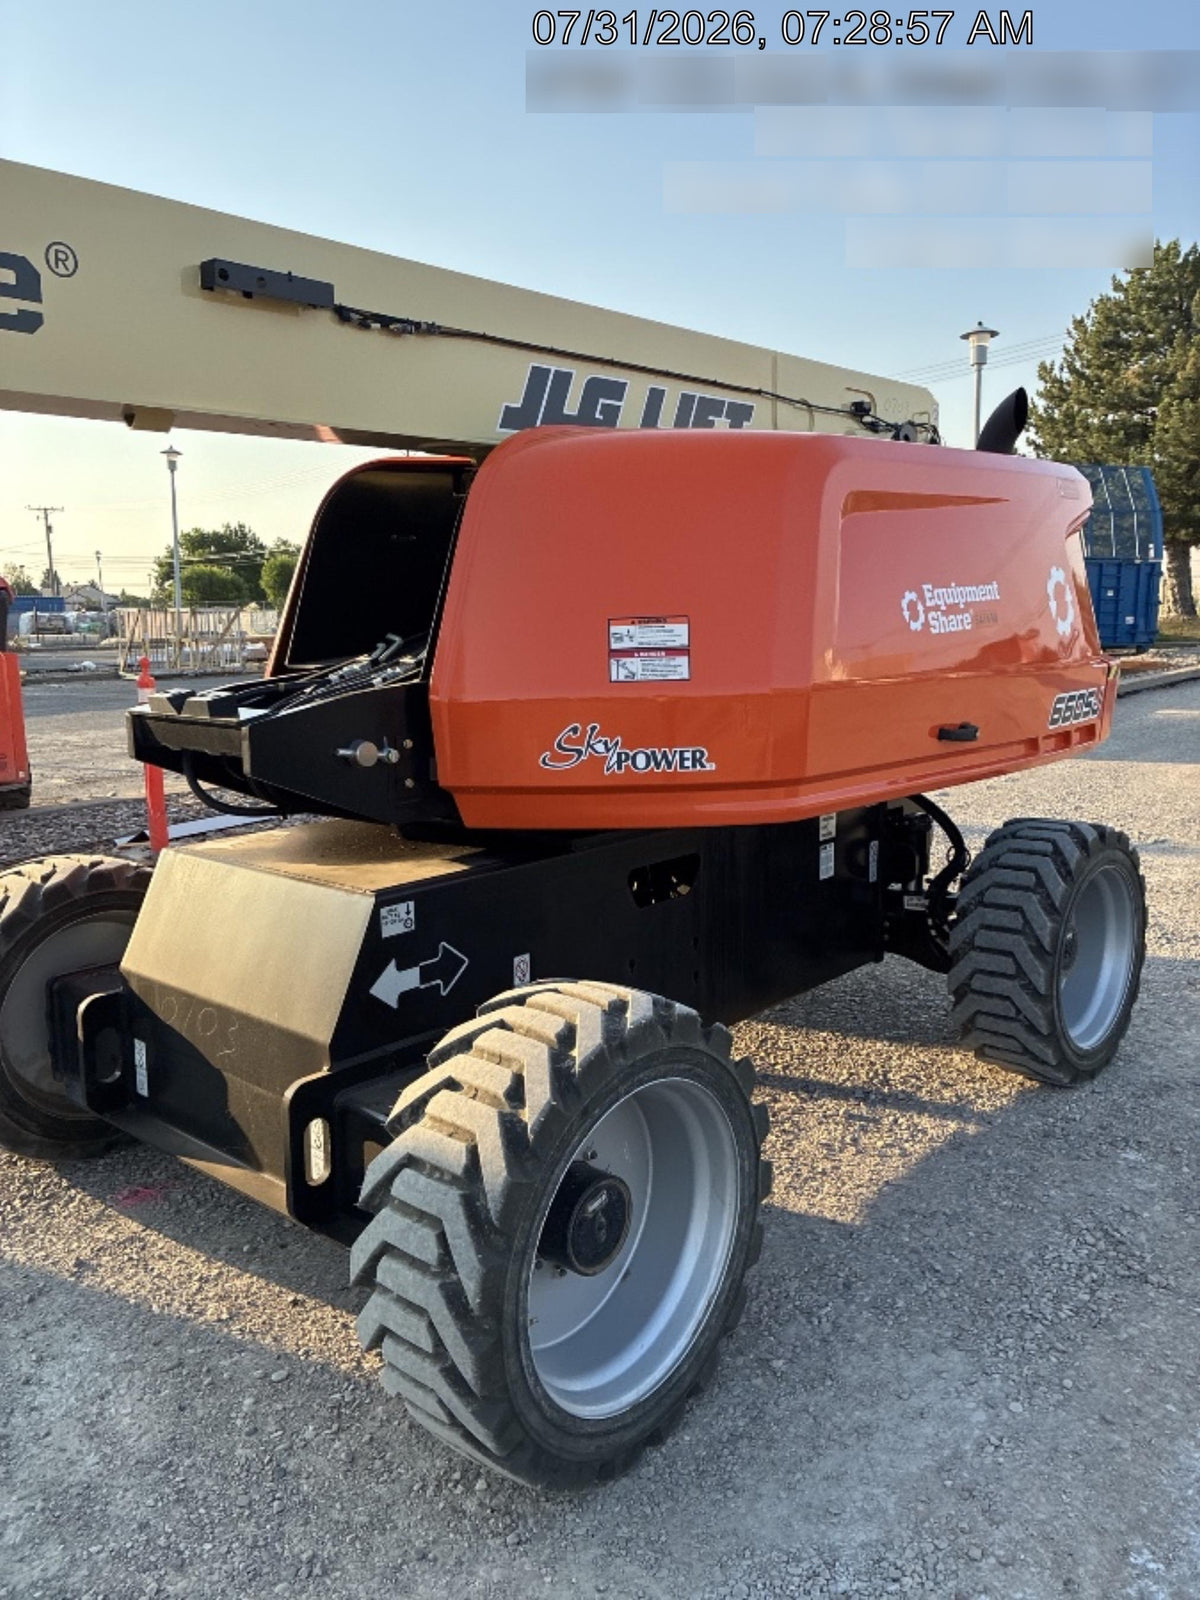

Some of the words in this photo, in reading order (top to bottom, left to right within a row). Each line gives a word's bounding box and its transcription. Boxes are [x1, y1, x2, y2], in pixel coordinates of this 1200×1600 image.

[497, 363, 630, 432] JLG
[922, 581, 1000, 609] Equipment
[928, 612, 972, 634] Share
